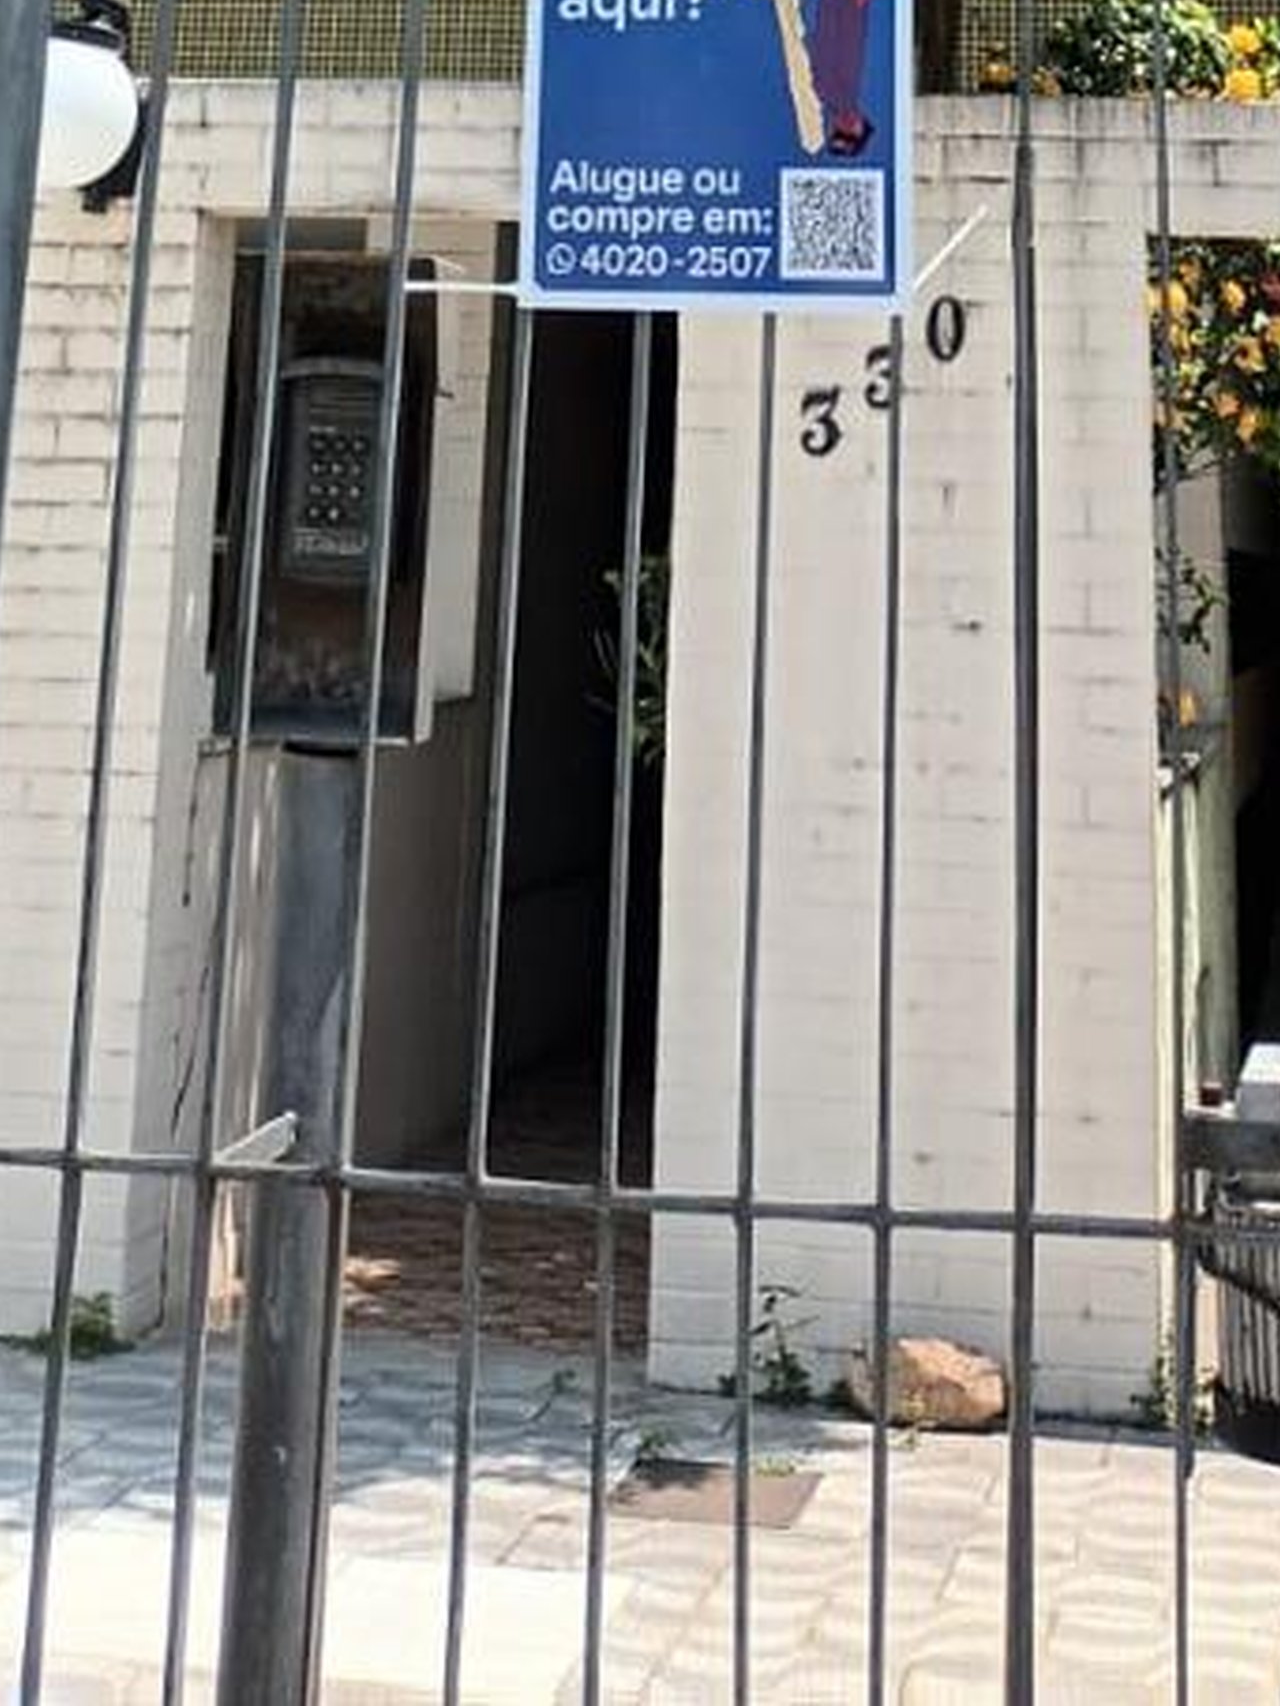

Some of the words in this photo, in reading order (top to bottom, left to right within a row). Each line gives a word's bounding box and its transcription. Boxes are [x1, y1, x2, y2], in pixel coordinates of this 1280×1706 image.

[549, 159, 684, 203] Alugue
[693, 167, 741, 196] ou
[546, 204, 695, 241] compre
[702, 206, 774, 234] em:
[580, 243, 773, 279] 4020-2507
